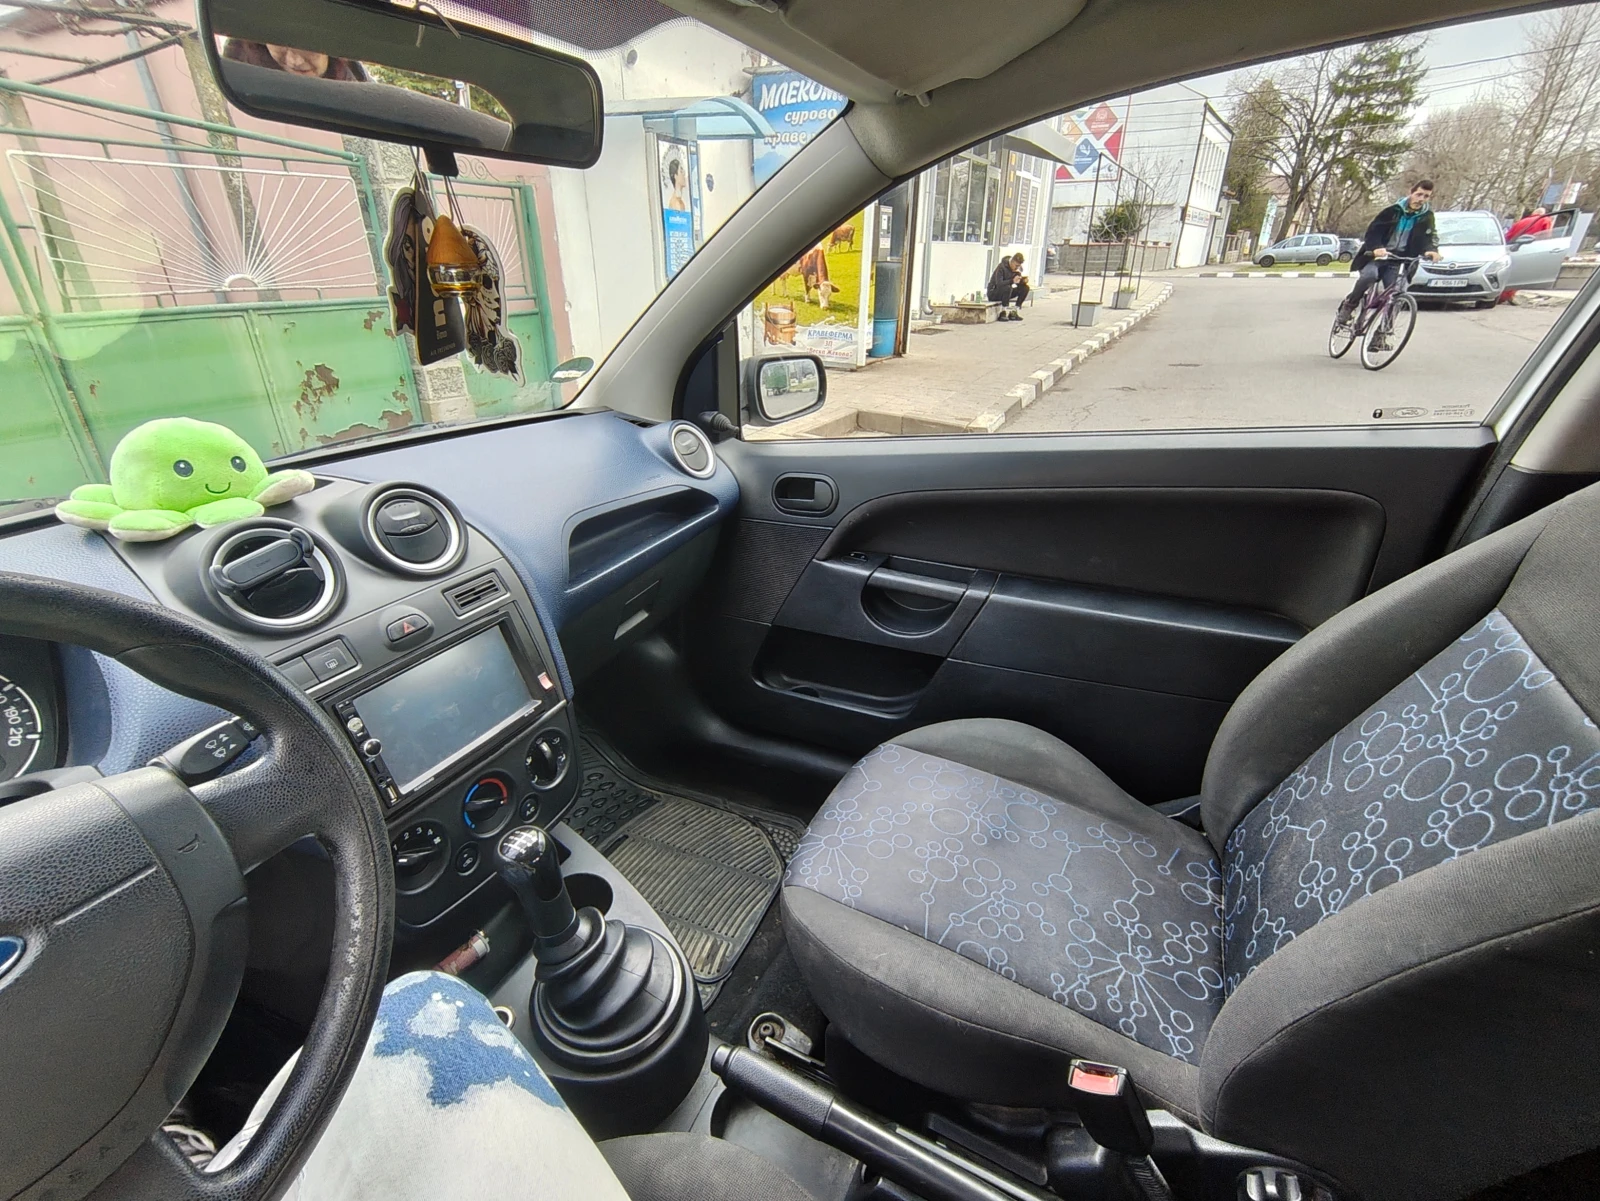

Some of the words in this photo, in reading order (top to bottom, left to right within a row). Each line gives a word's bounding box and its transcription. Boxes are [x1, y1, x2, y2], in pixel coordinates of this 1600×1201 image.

[784, 108, 838, 126] сурово
[807, 329, 853, 341] КРАВЕФЕРМА
[3, 705, 22, 725] 190
[7, 727, 24, 747] 210
[403, 832, 410, 840] 2
[416, 826, 423, 835] 3
[427, 828, 434, 836] 4
